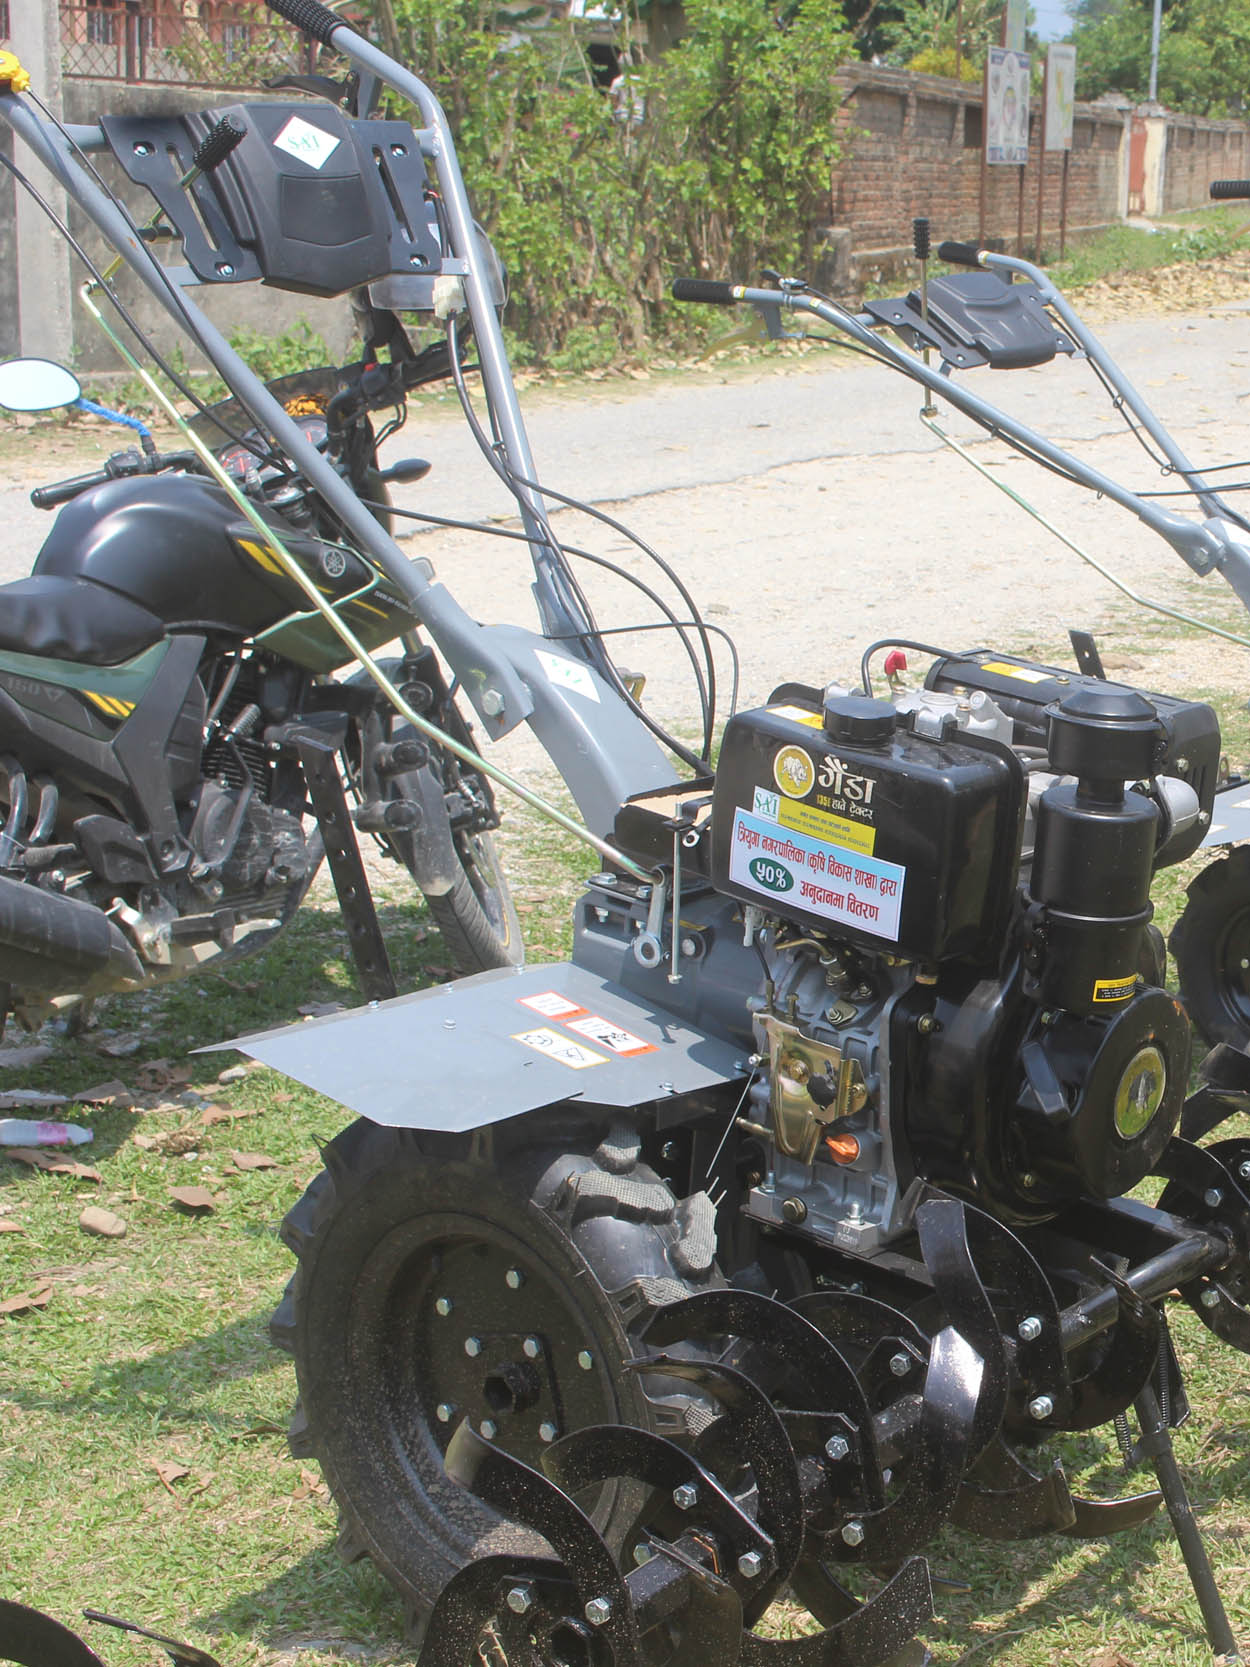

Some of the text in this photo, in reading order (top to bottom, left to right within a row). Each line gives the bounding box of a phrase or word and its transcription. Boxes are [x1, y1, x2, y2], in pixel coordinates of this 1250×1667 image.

[818, 755, 877, 803] गैंडा
[755, 790, 778, 815] SAI
[755, 860, 787, 889] ५०%
[762, 839, 804, 865] नगरपालिका
[828, 854, 853, 881] विकास
[800, 880, 879, 921] अनुदानमा वितरण
